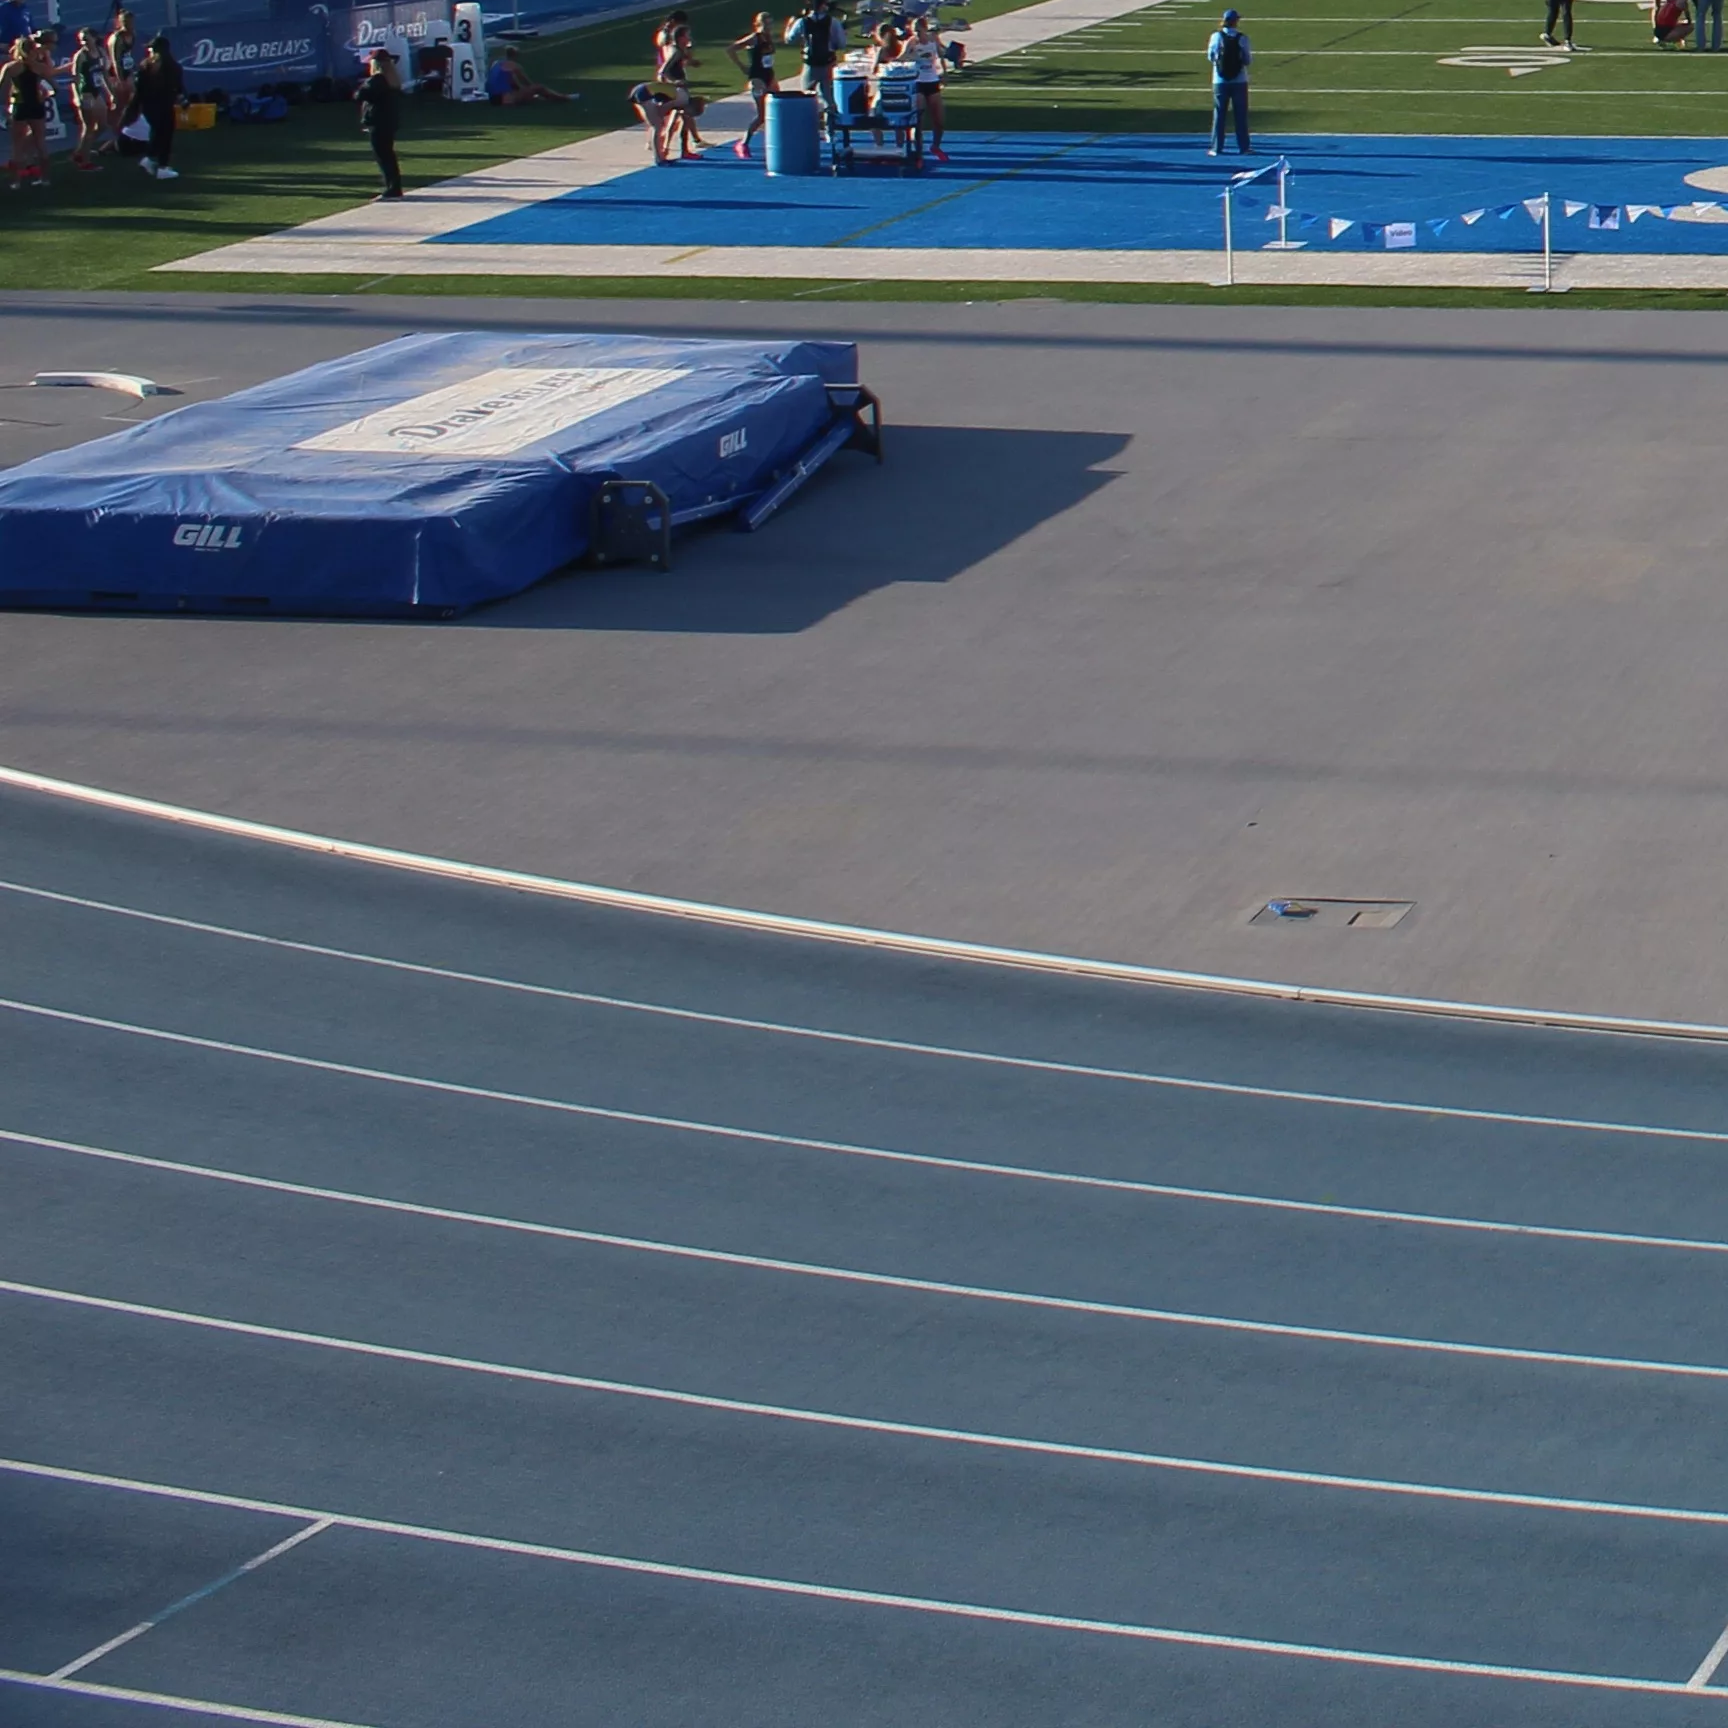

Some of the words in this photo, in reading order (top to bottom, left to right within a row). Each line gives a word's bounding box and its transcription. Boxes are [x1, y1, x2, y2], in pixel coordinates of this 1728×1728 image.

[457, 19, 472, 41] 3
[193, 38, 259, 66] Drake
[259, 38, 311, 60] RELAYS
[460, 59, 475, 84] 6
[387, 398, 514, 440] Drake
[719, 426, 748, 459] GILL
[172, 523, 242, 549] GILL
